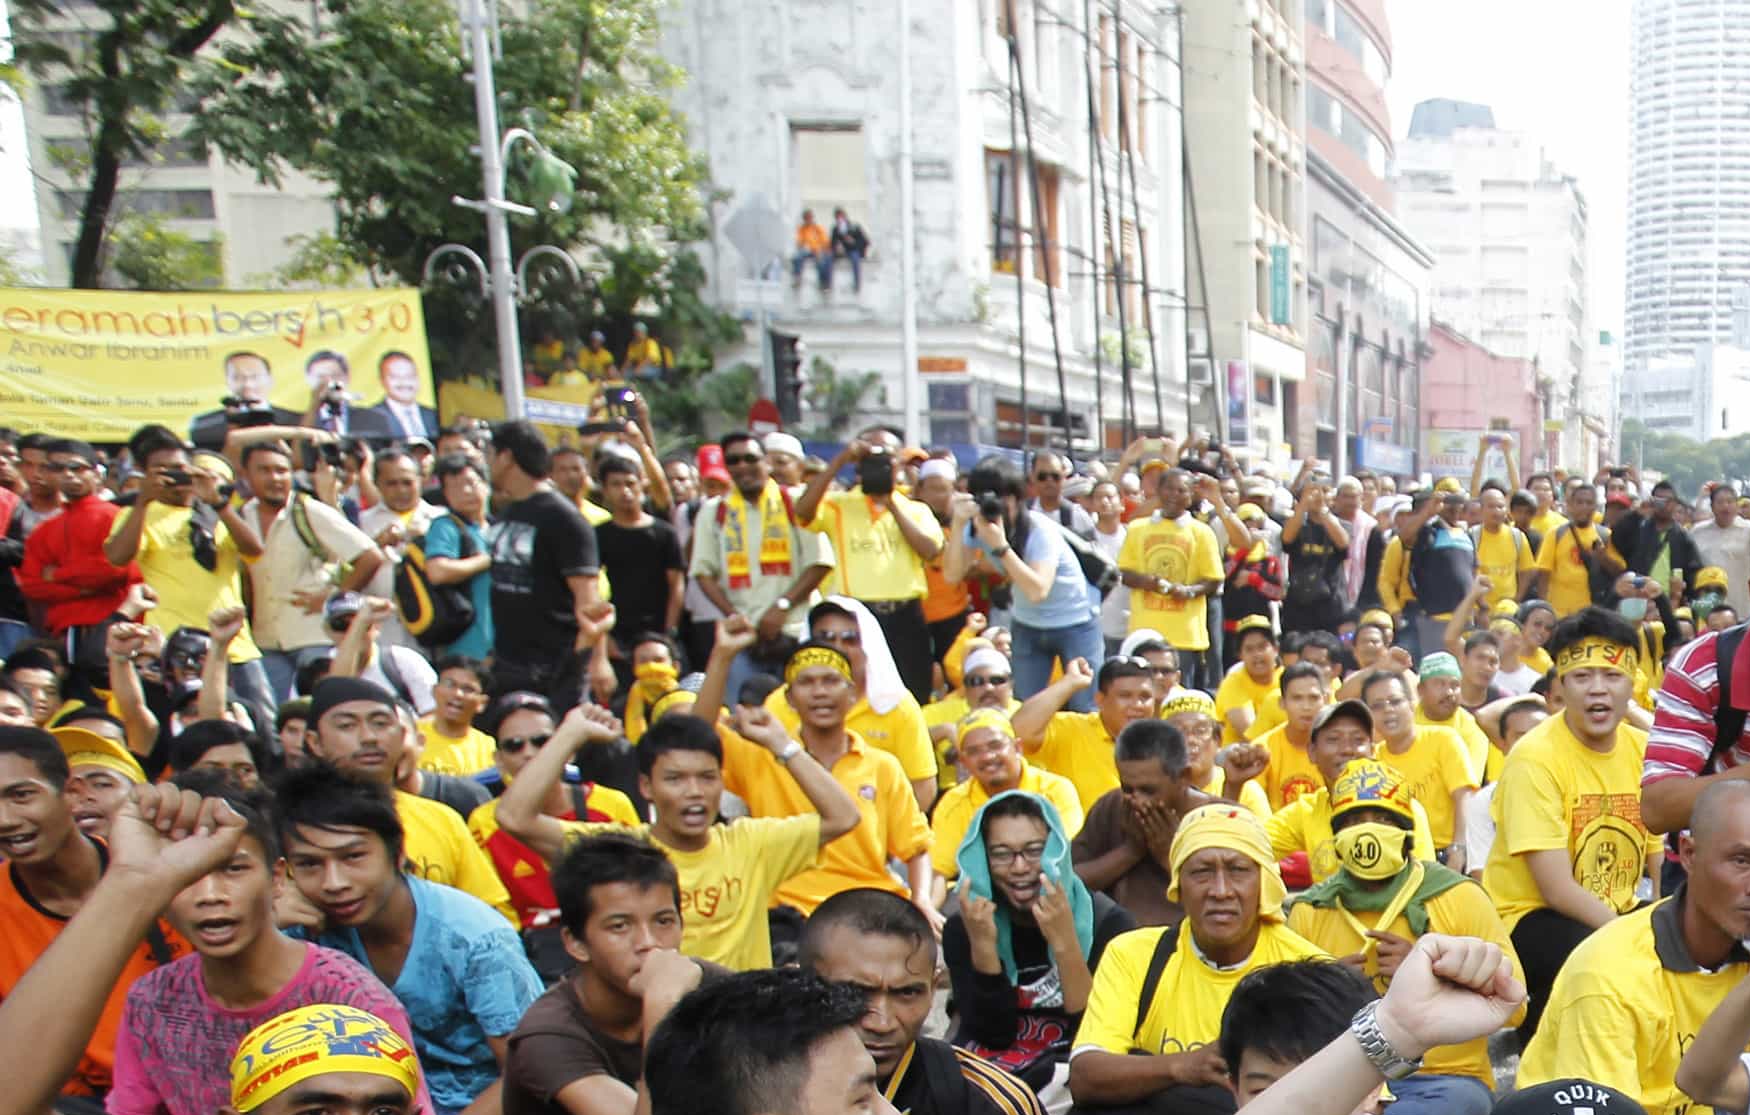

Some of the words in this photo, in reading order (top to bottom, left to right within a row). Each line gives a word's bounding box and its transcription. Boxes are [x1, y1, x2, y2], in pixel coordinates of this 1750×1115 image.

[354, 303, 412, 333] 3.0
[7, 338, 98, 361] Anwar
[107, 343, 210, 362] Ibrahim
[1355, 842, 1376, 860] 3.0
[1554, 1085, 1610, 1106] QUIK
